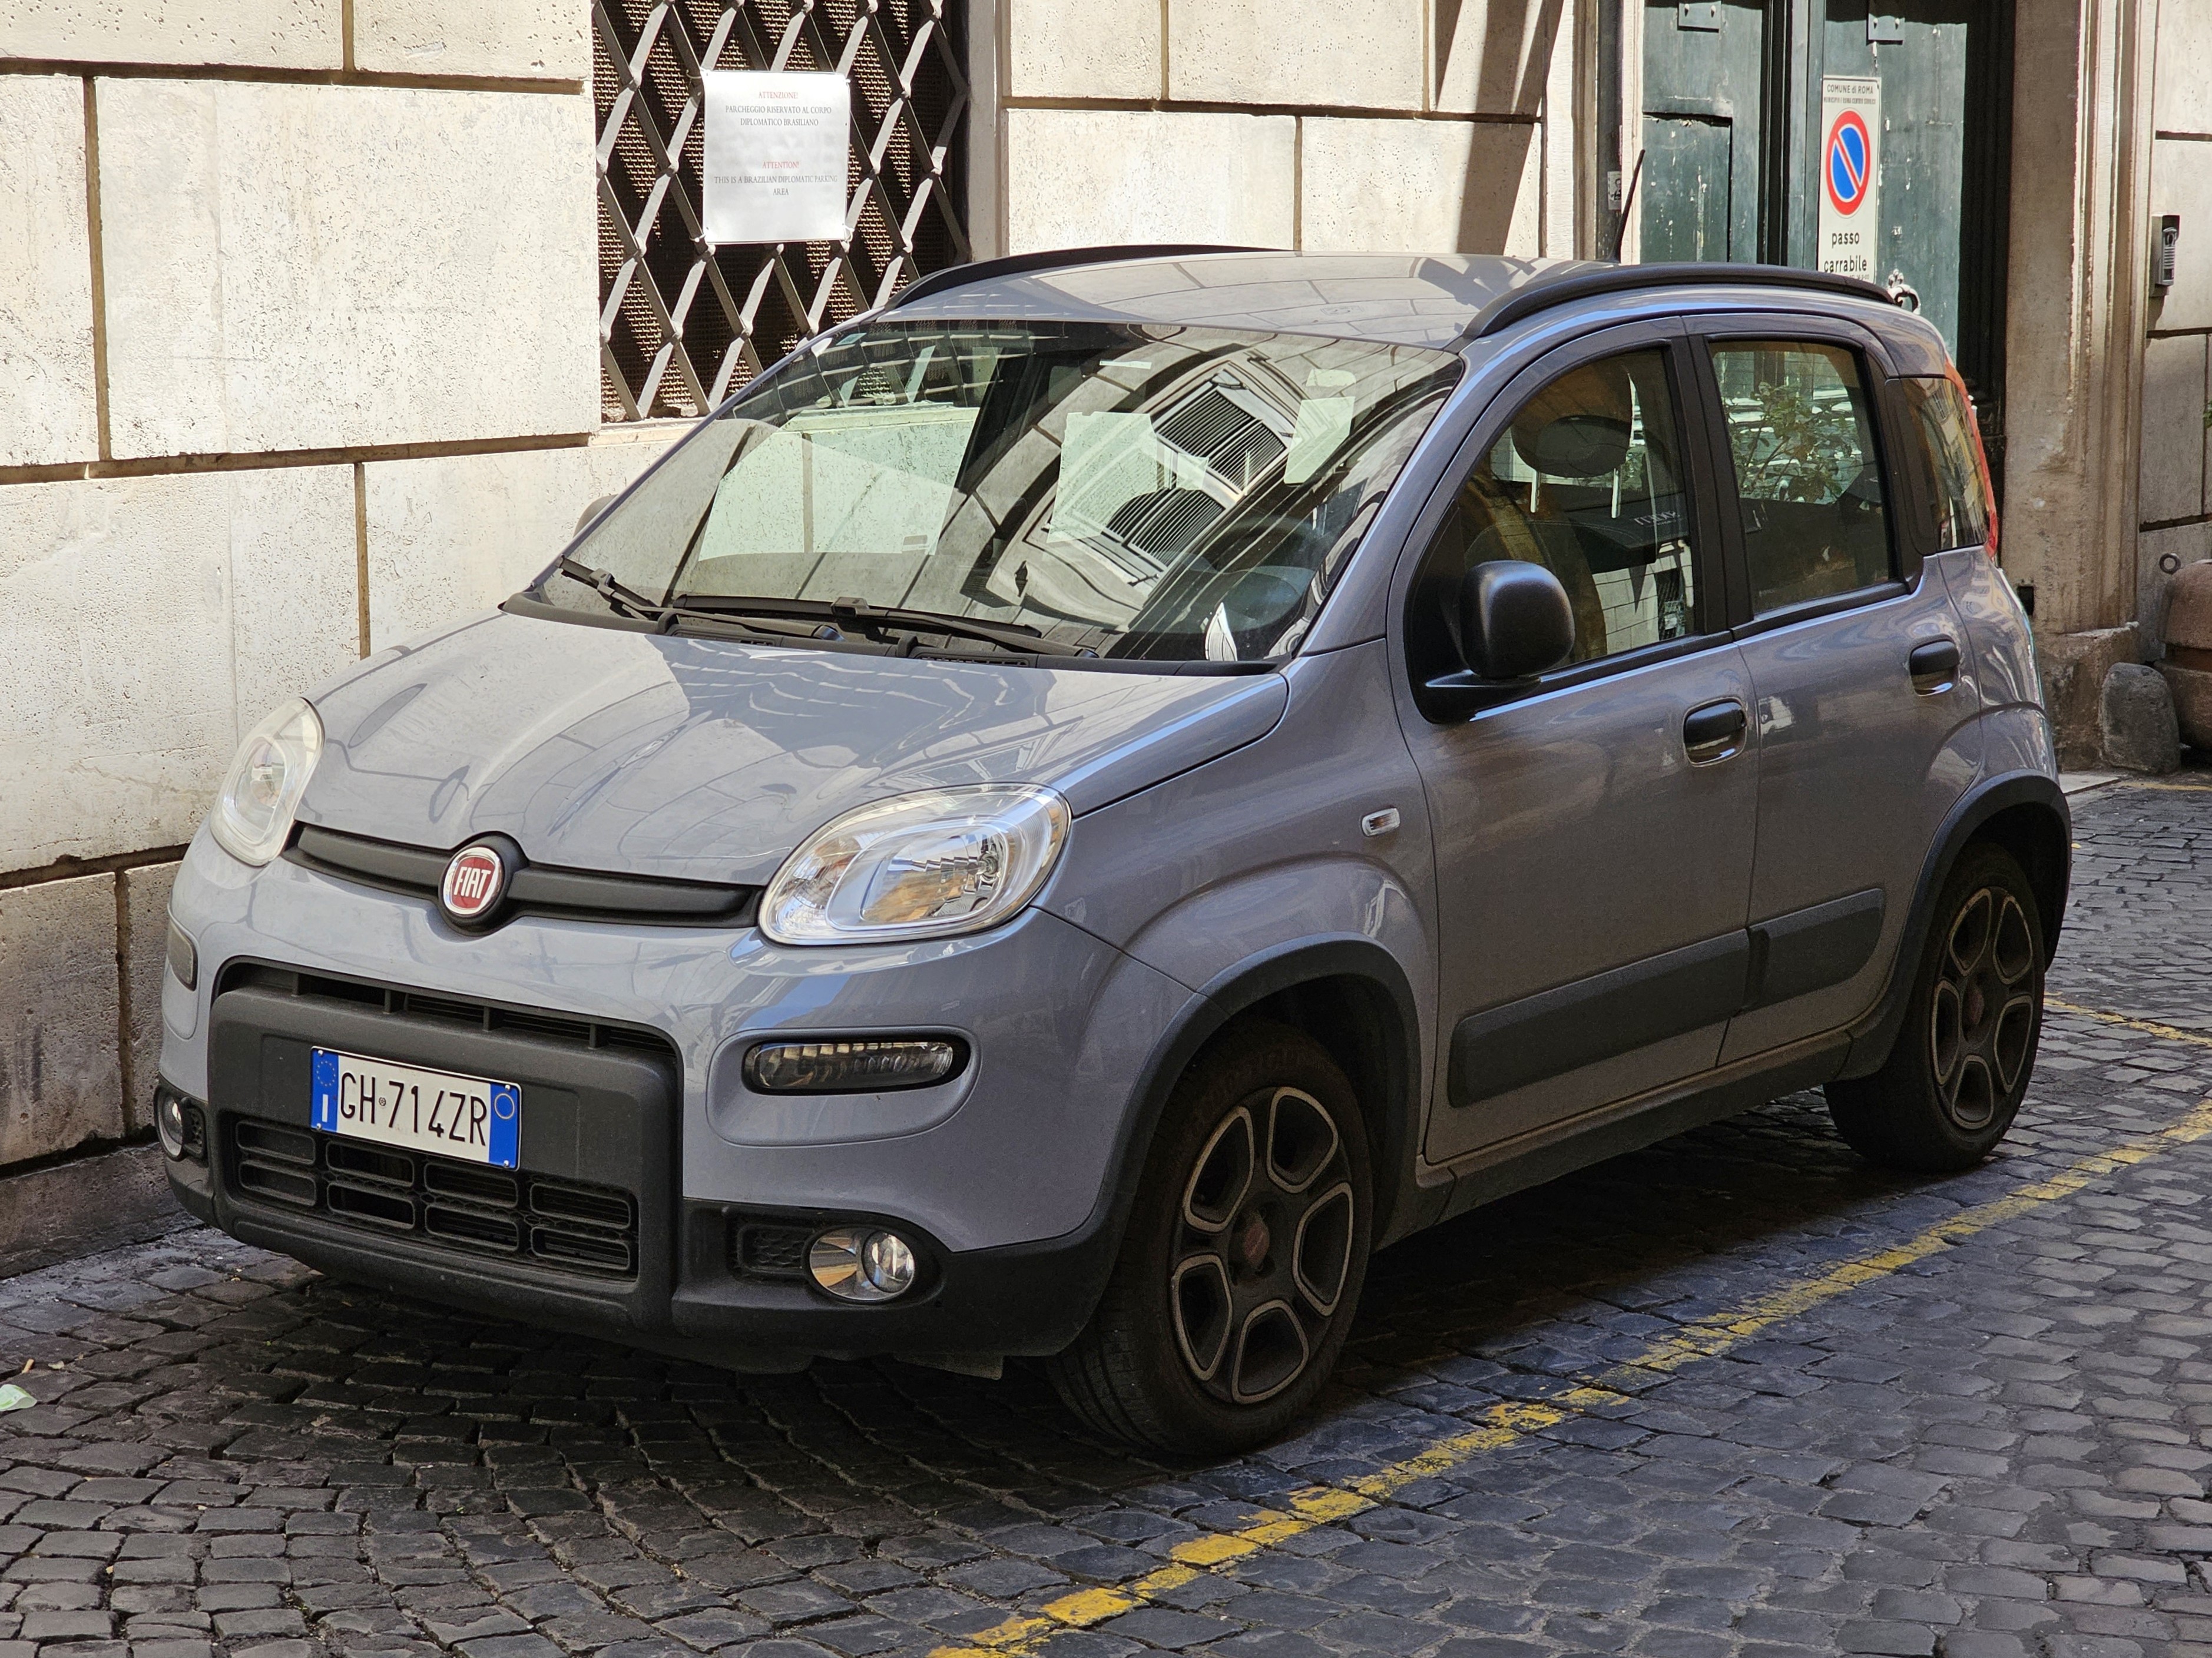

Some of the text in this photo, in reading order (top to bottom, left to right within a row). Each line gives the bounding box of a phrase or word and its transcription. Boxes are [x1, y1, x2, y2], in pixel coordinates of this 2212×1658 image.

[1827, 84, 1873, 94] COMUNE di ROMA
[725, 105, 766, 114] PARCHEGGIO
[767, 105, 801, 114] RISERVATO
[740, 118, 782, 126] DIPLOMATICO
[762, 161, 799, 169] ATTENTION!
[778, 175, 814, 183] DIPLOMATIC
[814, 175, 837, 183] PARKING
[1832, 232, 1860, 248] passo
[1824, 254, 1867, 273] carrabile
[453, 866, 491, 899] FIAT
